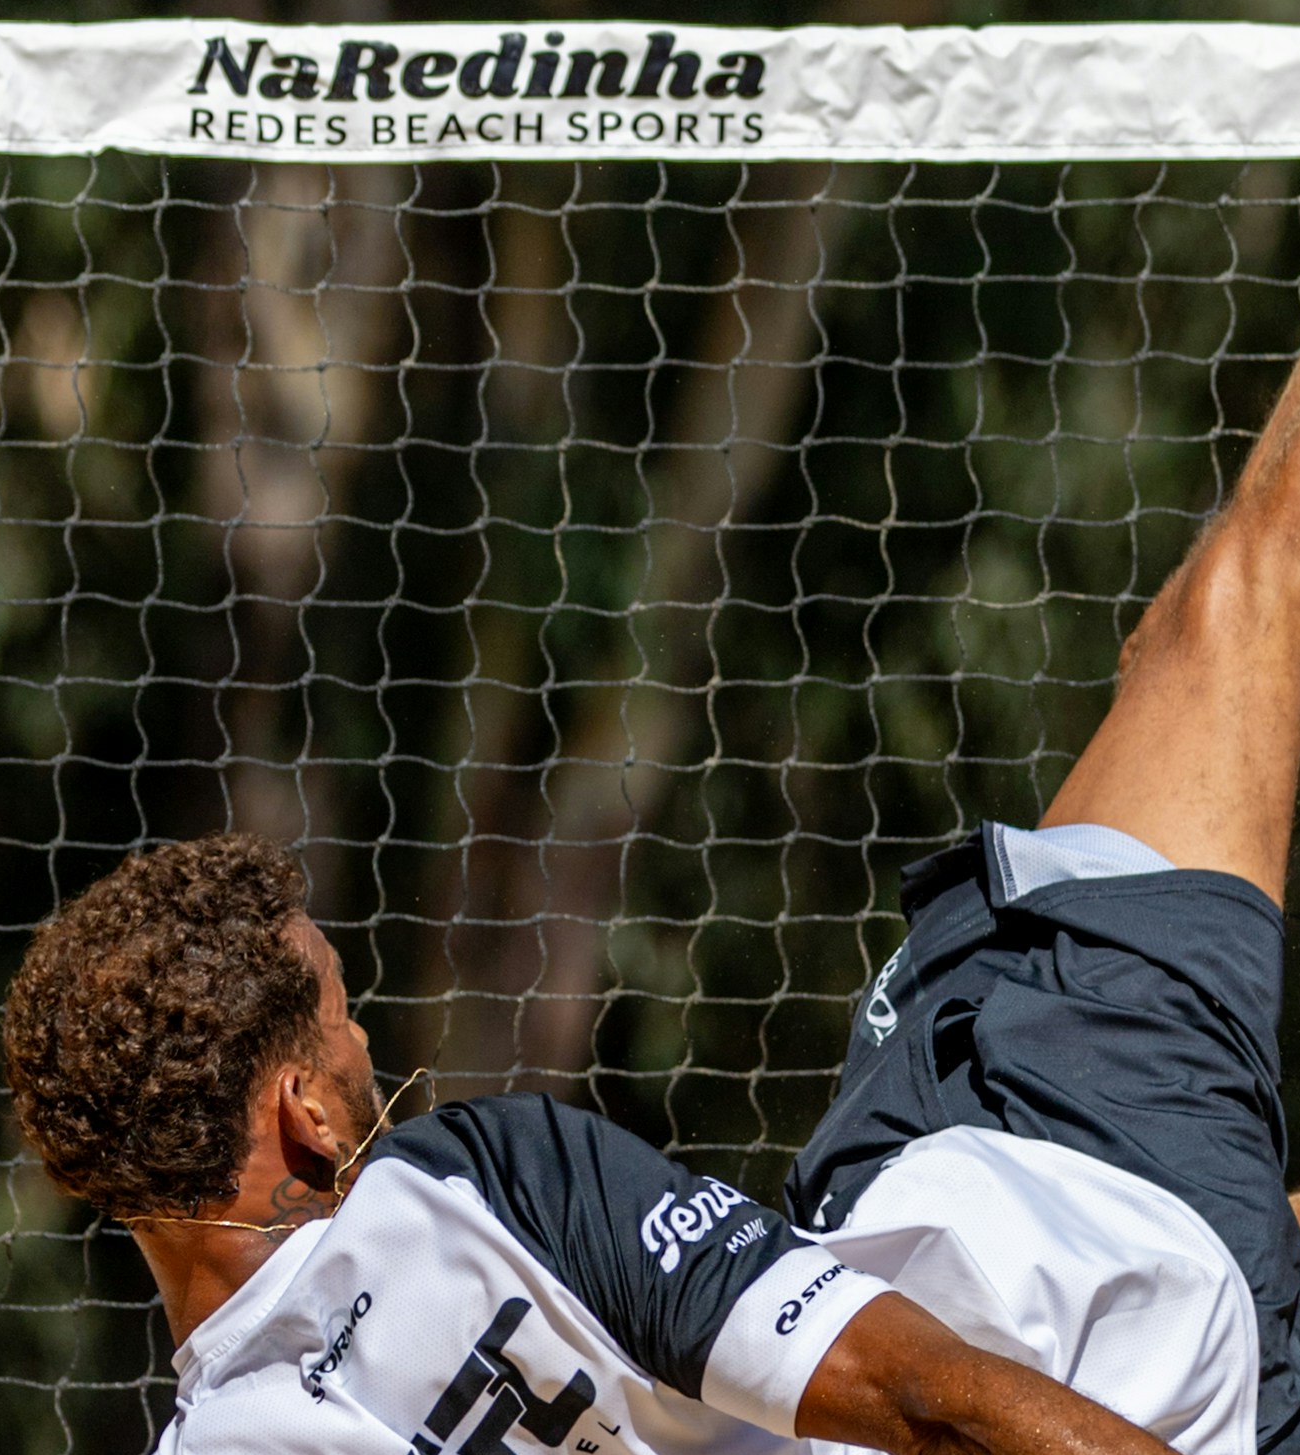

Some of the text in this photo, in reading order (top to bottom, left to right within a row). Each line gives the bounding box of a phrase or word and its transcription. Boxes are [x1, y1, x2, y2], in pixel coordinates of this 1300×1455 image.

[187, 31, 766, 101] NaRedinha
[190, 108, 764, 144] REDES BEACH SPORTS
[641, 1175, 760, 1274] Tend
[726, 1217, 769, 1254] MIAMI
[801, 1263, 849, 1304] STOR
